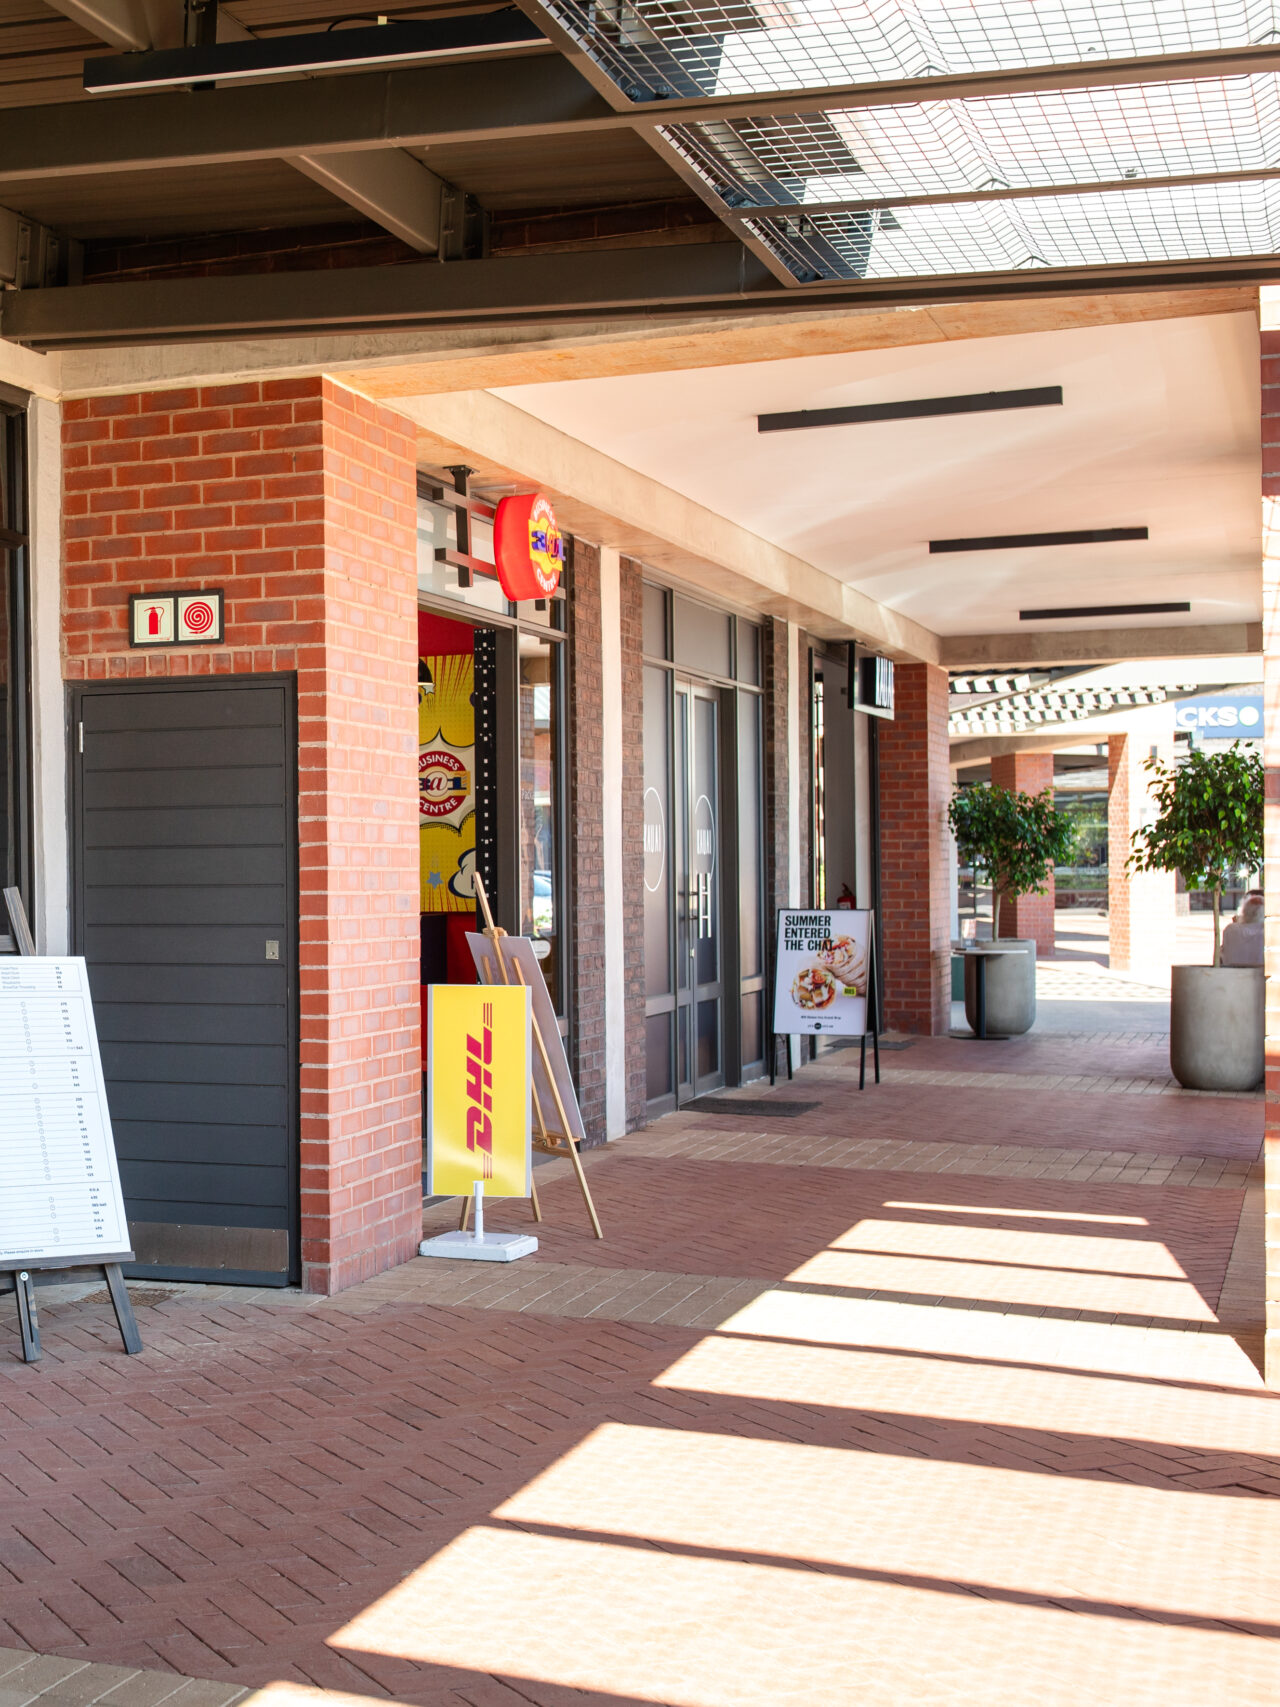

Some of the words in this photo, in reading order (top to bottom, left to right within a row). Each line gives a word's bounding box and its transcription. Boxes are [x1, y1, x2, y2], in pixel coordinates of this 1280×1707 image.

[785, 915, 831, 927] SUMMER
[785, 928, 830, 939] ENTERED
[784, 940, 804, 951] THE
[807, 940, 834, 951] CHAT
[466, 1026, 493, 1155] DHL
